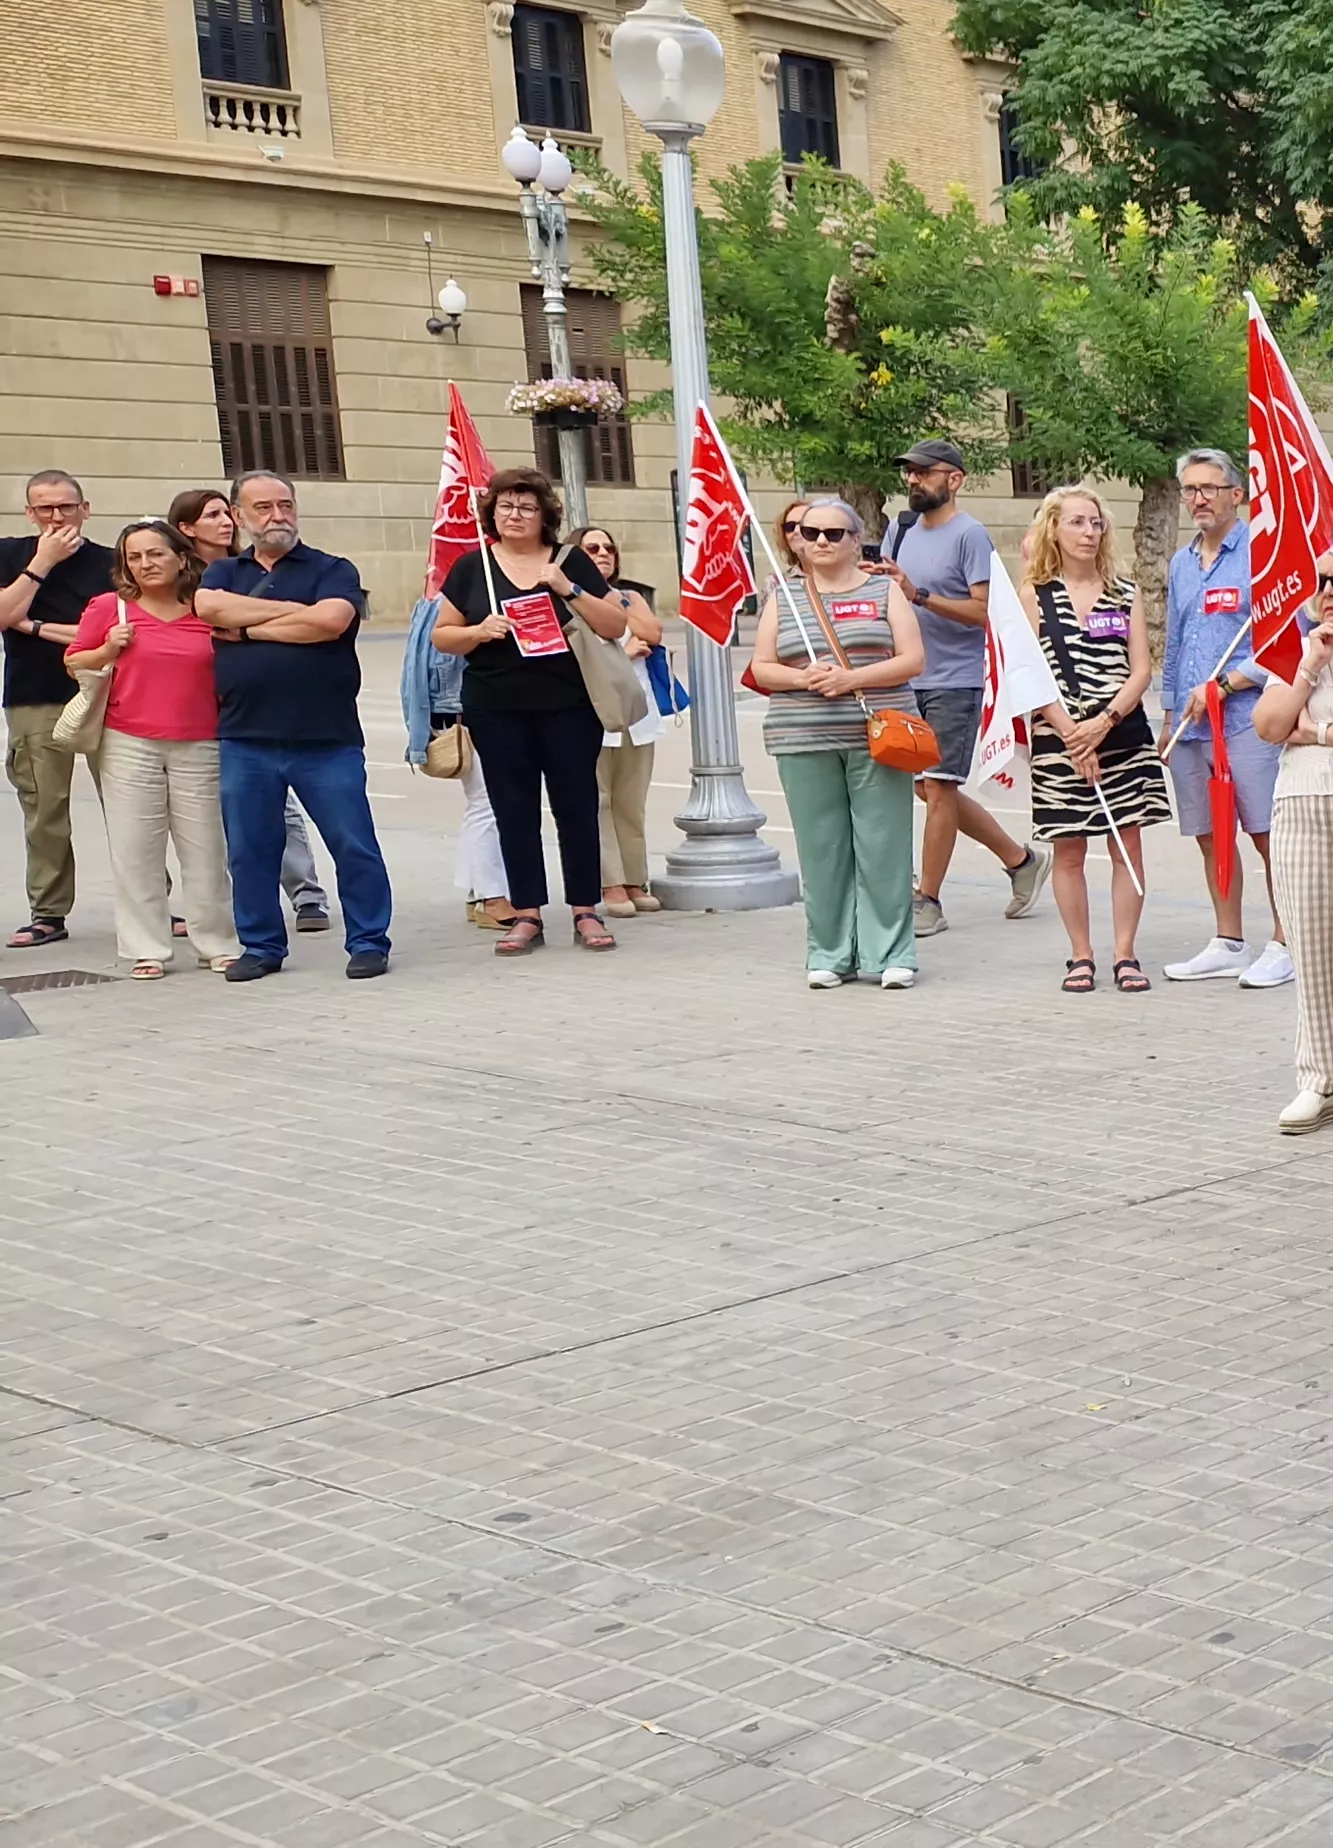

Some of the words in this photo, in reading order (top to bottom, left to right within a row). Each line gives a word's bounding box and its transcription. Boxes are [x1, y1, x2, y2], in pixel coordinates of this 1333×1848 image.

[1206, 593, 1222, 605] UGT
[835, 604, 858, 615] UGT
[1089, 616, 1111, 629] UGT
